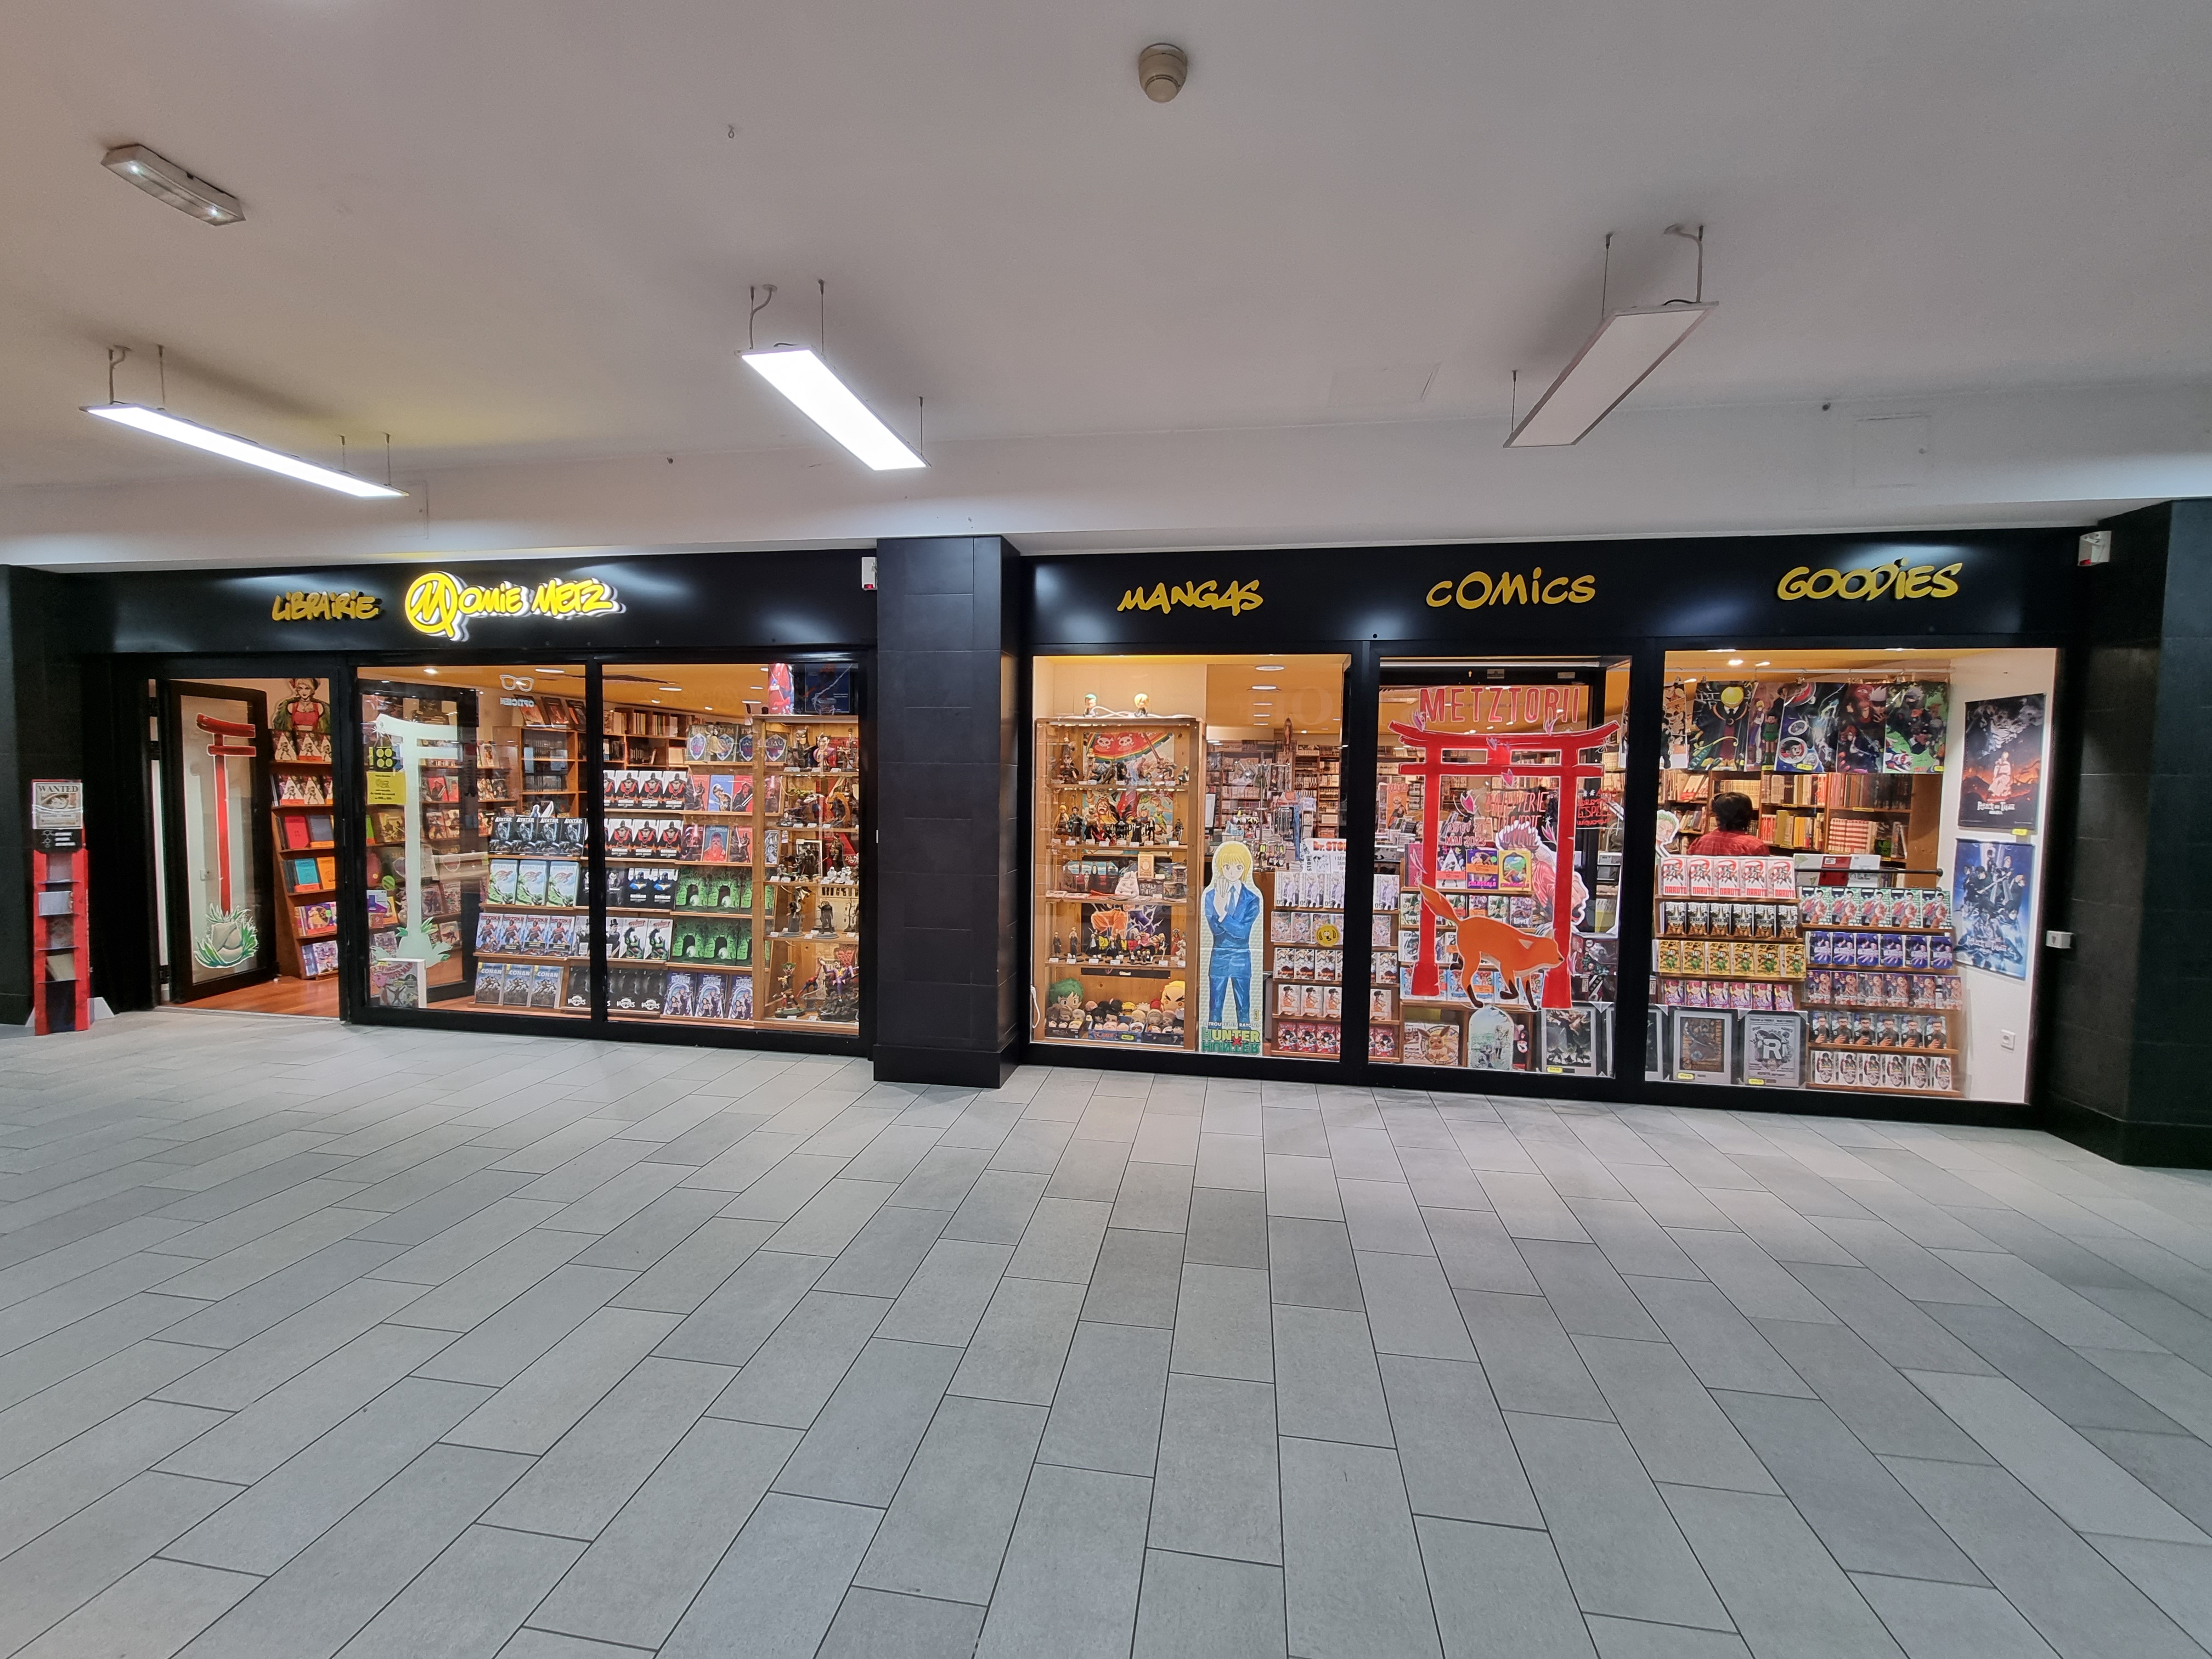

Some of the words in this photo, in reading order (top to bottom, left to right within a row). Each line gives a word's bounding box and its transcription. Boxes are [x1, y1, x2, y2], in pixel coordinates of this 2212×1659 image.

[1777, 557, 1963, 601] GOODIES
[1425, 567, 1596, 610] COMICS
[1117, 579, 1263, 616] MANGAS
[1313, 841, 1324, 851] Dr.
[1464, 836, 1487, 847] 2023
[1665, 886, 1687, 894] NARUTO
[1720, 888, 1741, 896] NARUTO
[1747, 888, 1768, 896] NARUTO
[1775, 889, 1796, 898] NARUTO
[1201, 1026, 1261, 1043] HUNTER
